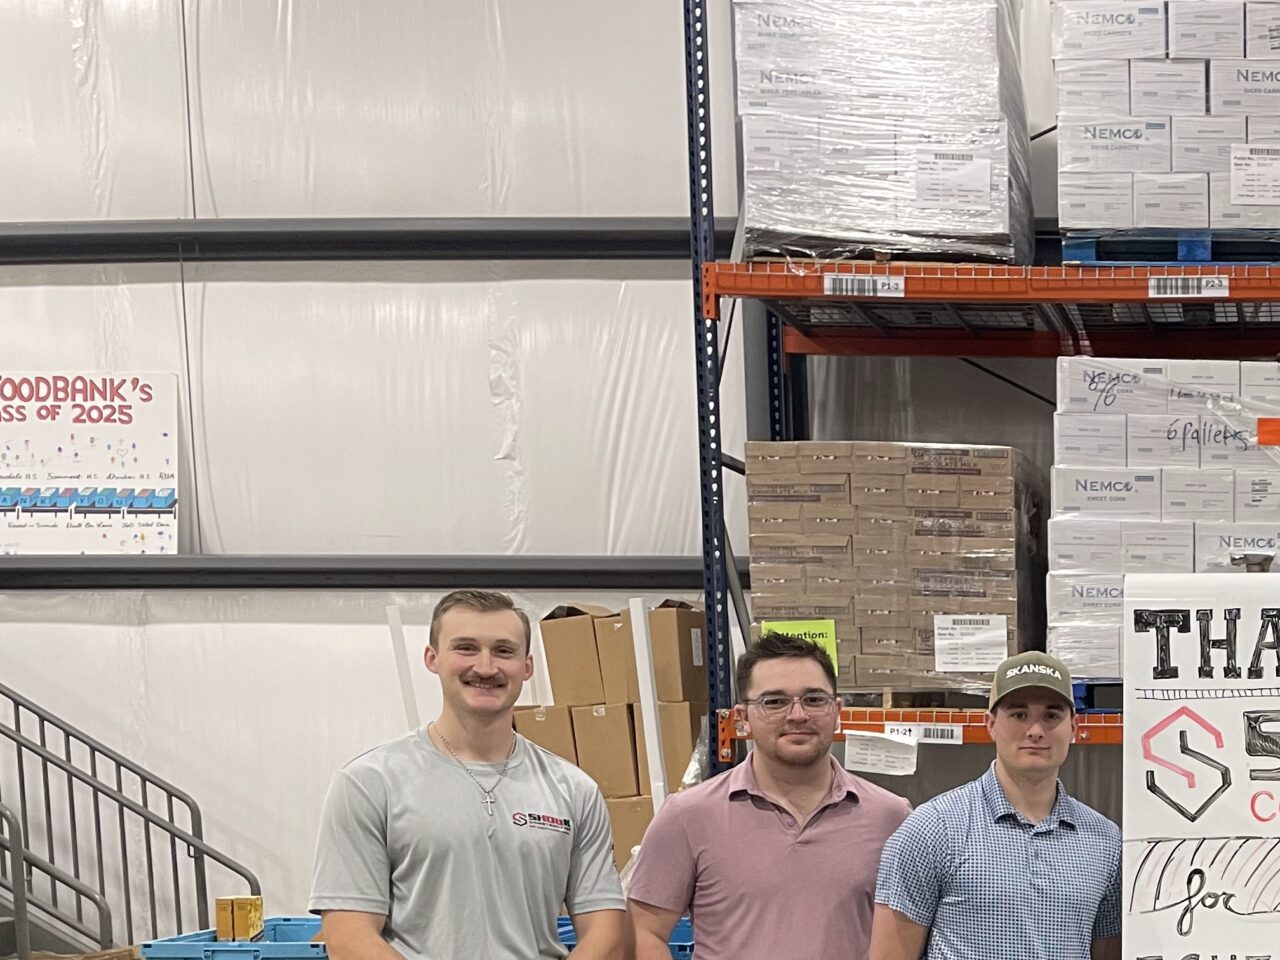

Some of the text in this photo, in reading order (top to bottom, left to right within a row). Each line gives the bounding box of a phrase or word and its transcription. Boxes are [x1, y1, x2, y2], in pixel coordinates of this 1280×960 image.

[1084, 126, 1143, 139] NEMCO
[882, 281, 899, 290] P1-3
[1205, 279, 1222, 287] P2-3
[0, 376, 153, 402] OODBANK's
[36, 404, 62, 421] OF
[72, 404, 133, 424] 2025
[1076, 479, 1133, 492] NEMCO
[1219, 536, 1275, 549] NEMCO
[780, 630, 828, 640] ttention:
[1006, 664, 1062, 680] SKANSKA
[890, 728, 909, 736] P1-2
[1176, 868, 1240, 937] for
